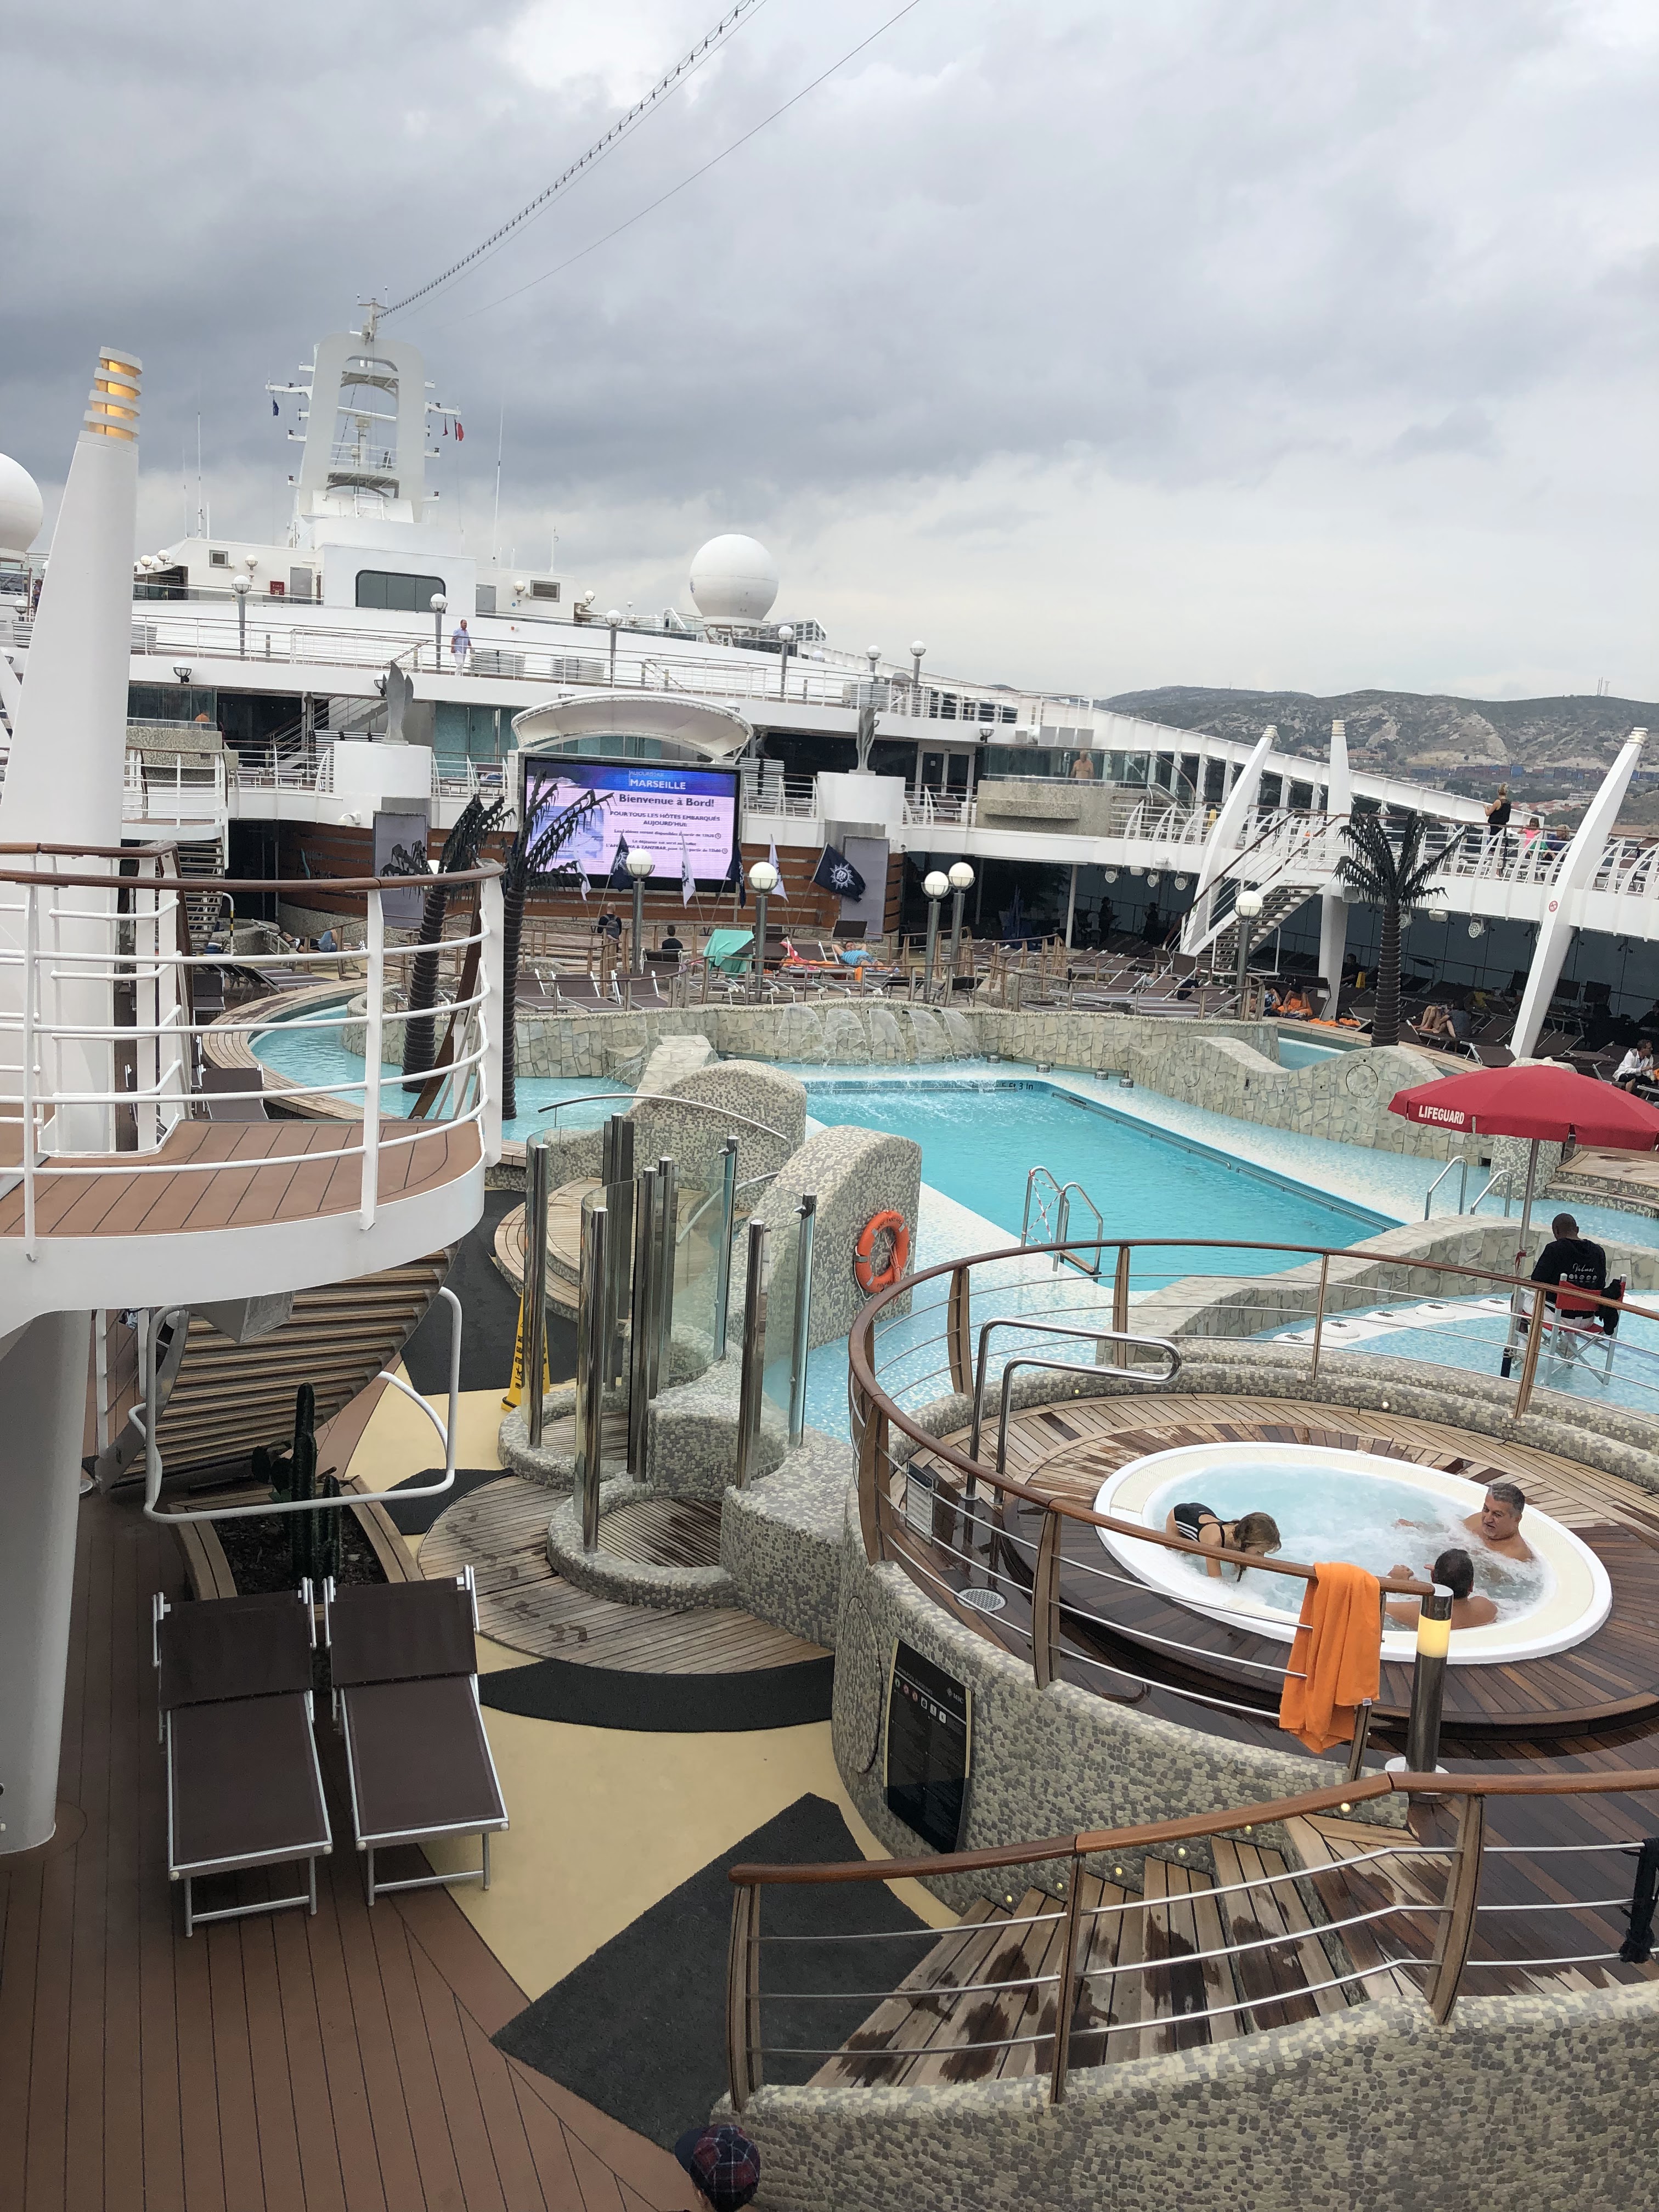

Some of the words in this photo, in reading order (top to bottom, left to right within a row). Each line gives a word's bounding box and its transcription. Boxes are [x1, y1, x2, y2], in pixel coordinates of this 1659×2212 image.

[630, 778, 686, 790] MARSEILLE
[619, 794, 674, 805] Bienvenue
[676, 797, 683, 806] à
[686, 798, 714, 807] Bord!
[1019, 1082, 1024, 1090] 3
[1026, 1082, 1034, 1090] In
[1418, 1105, 1465, 1125] LIFEGUARD
